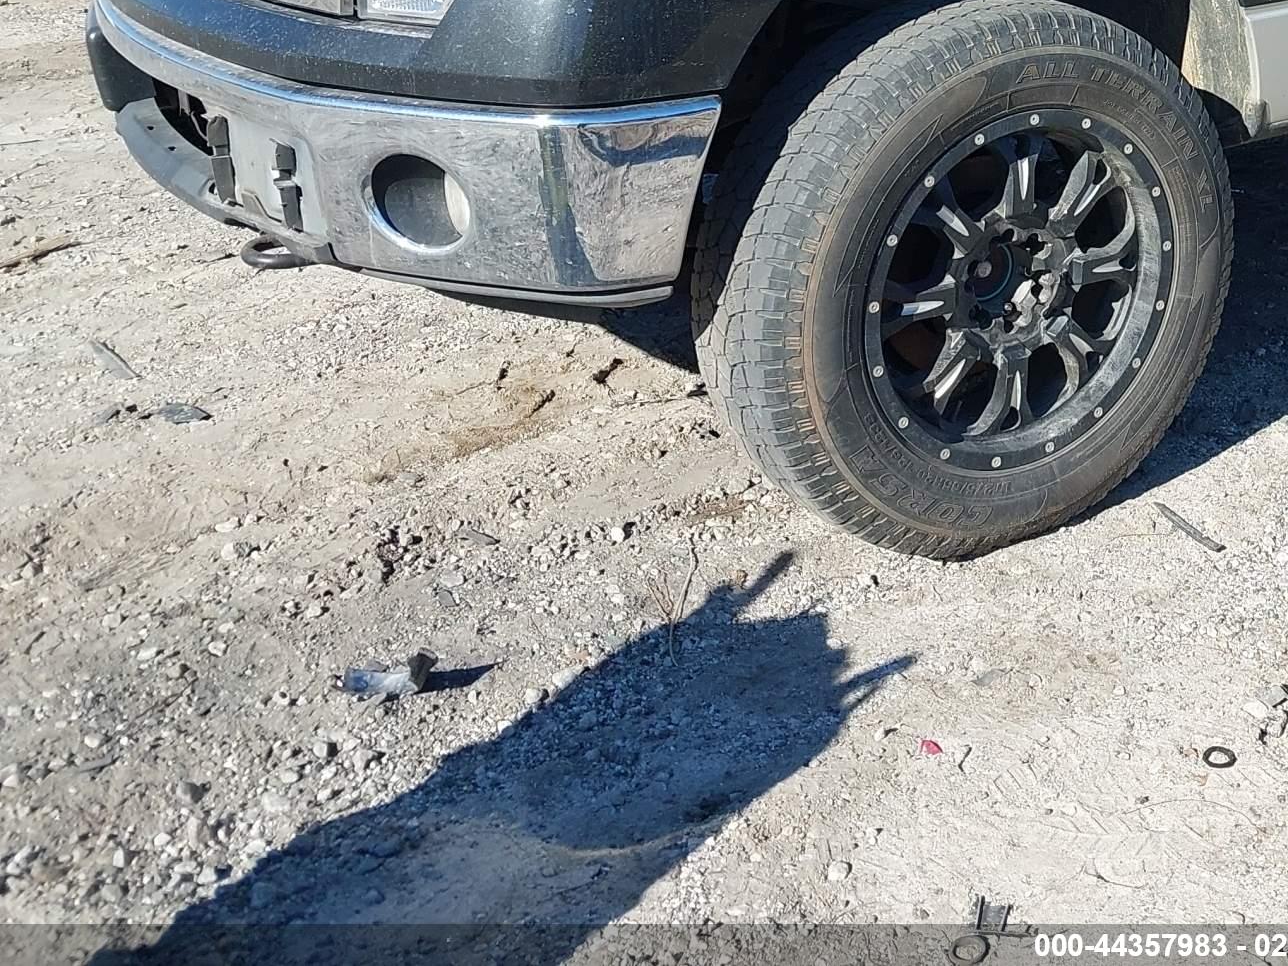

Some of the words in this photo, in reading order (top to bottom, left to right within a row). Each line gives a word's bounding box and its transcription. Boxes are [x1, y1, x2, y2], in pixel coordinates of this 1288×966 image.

[1016, 62, 1079, 84] ALL
[1090, 64, 1199, 161] TERRAIN
[849, 444, 994, 527] CORSA
